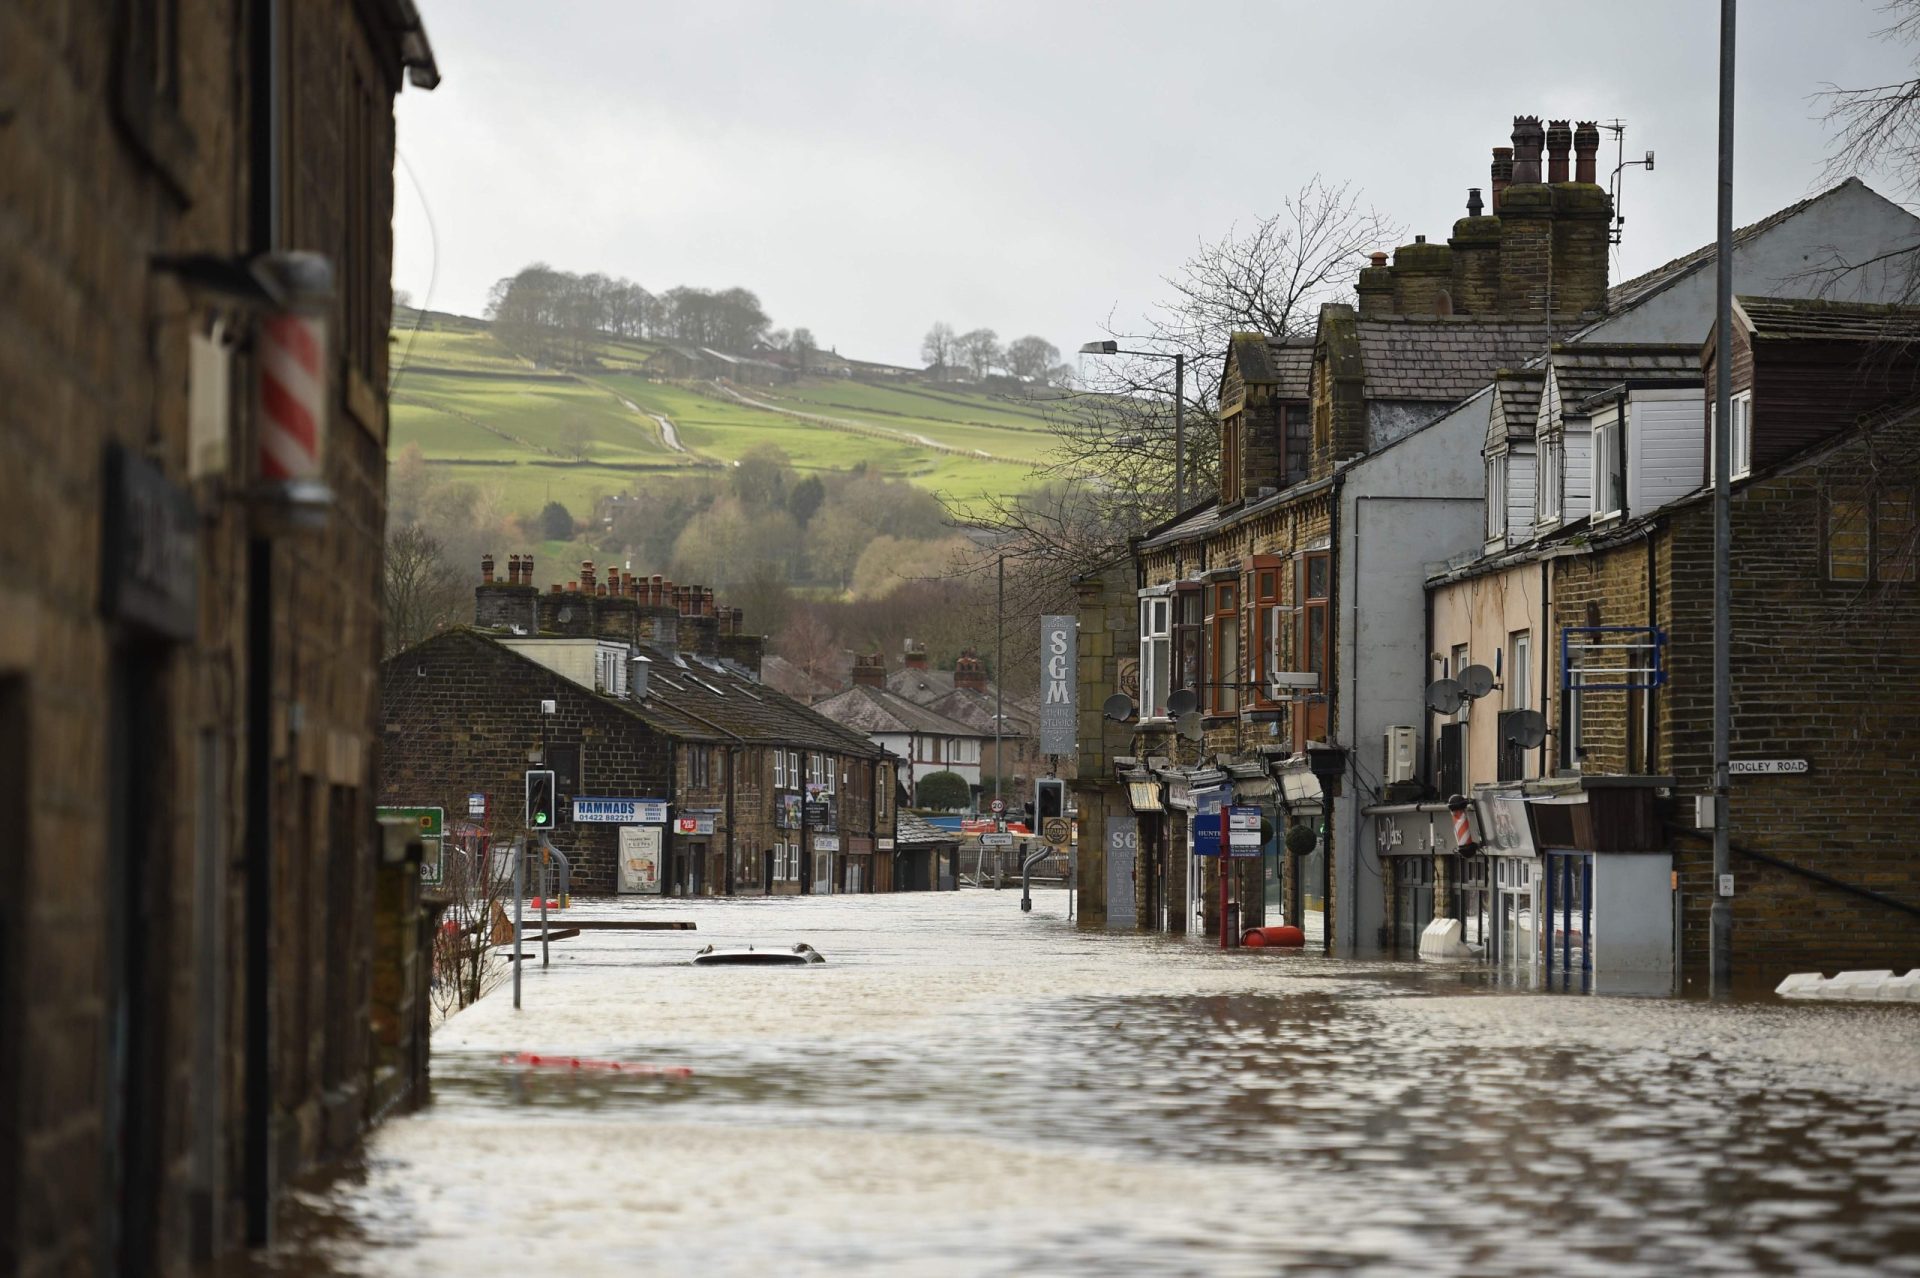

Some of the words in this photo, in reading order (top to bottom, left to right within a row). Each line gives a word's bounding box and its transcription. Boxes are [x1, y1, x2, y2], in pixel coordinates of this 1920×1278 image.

[1045, 630, 1071, 705] SGM
[1777, 761, 1805, 771] ROAD
[578, 801, 635, 814] HAMMADS
[1112, 832, 1137, 849] SG
